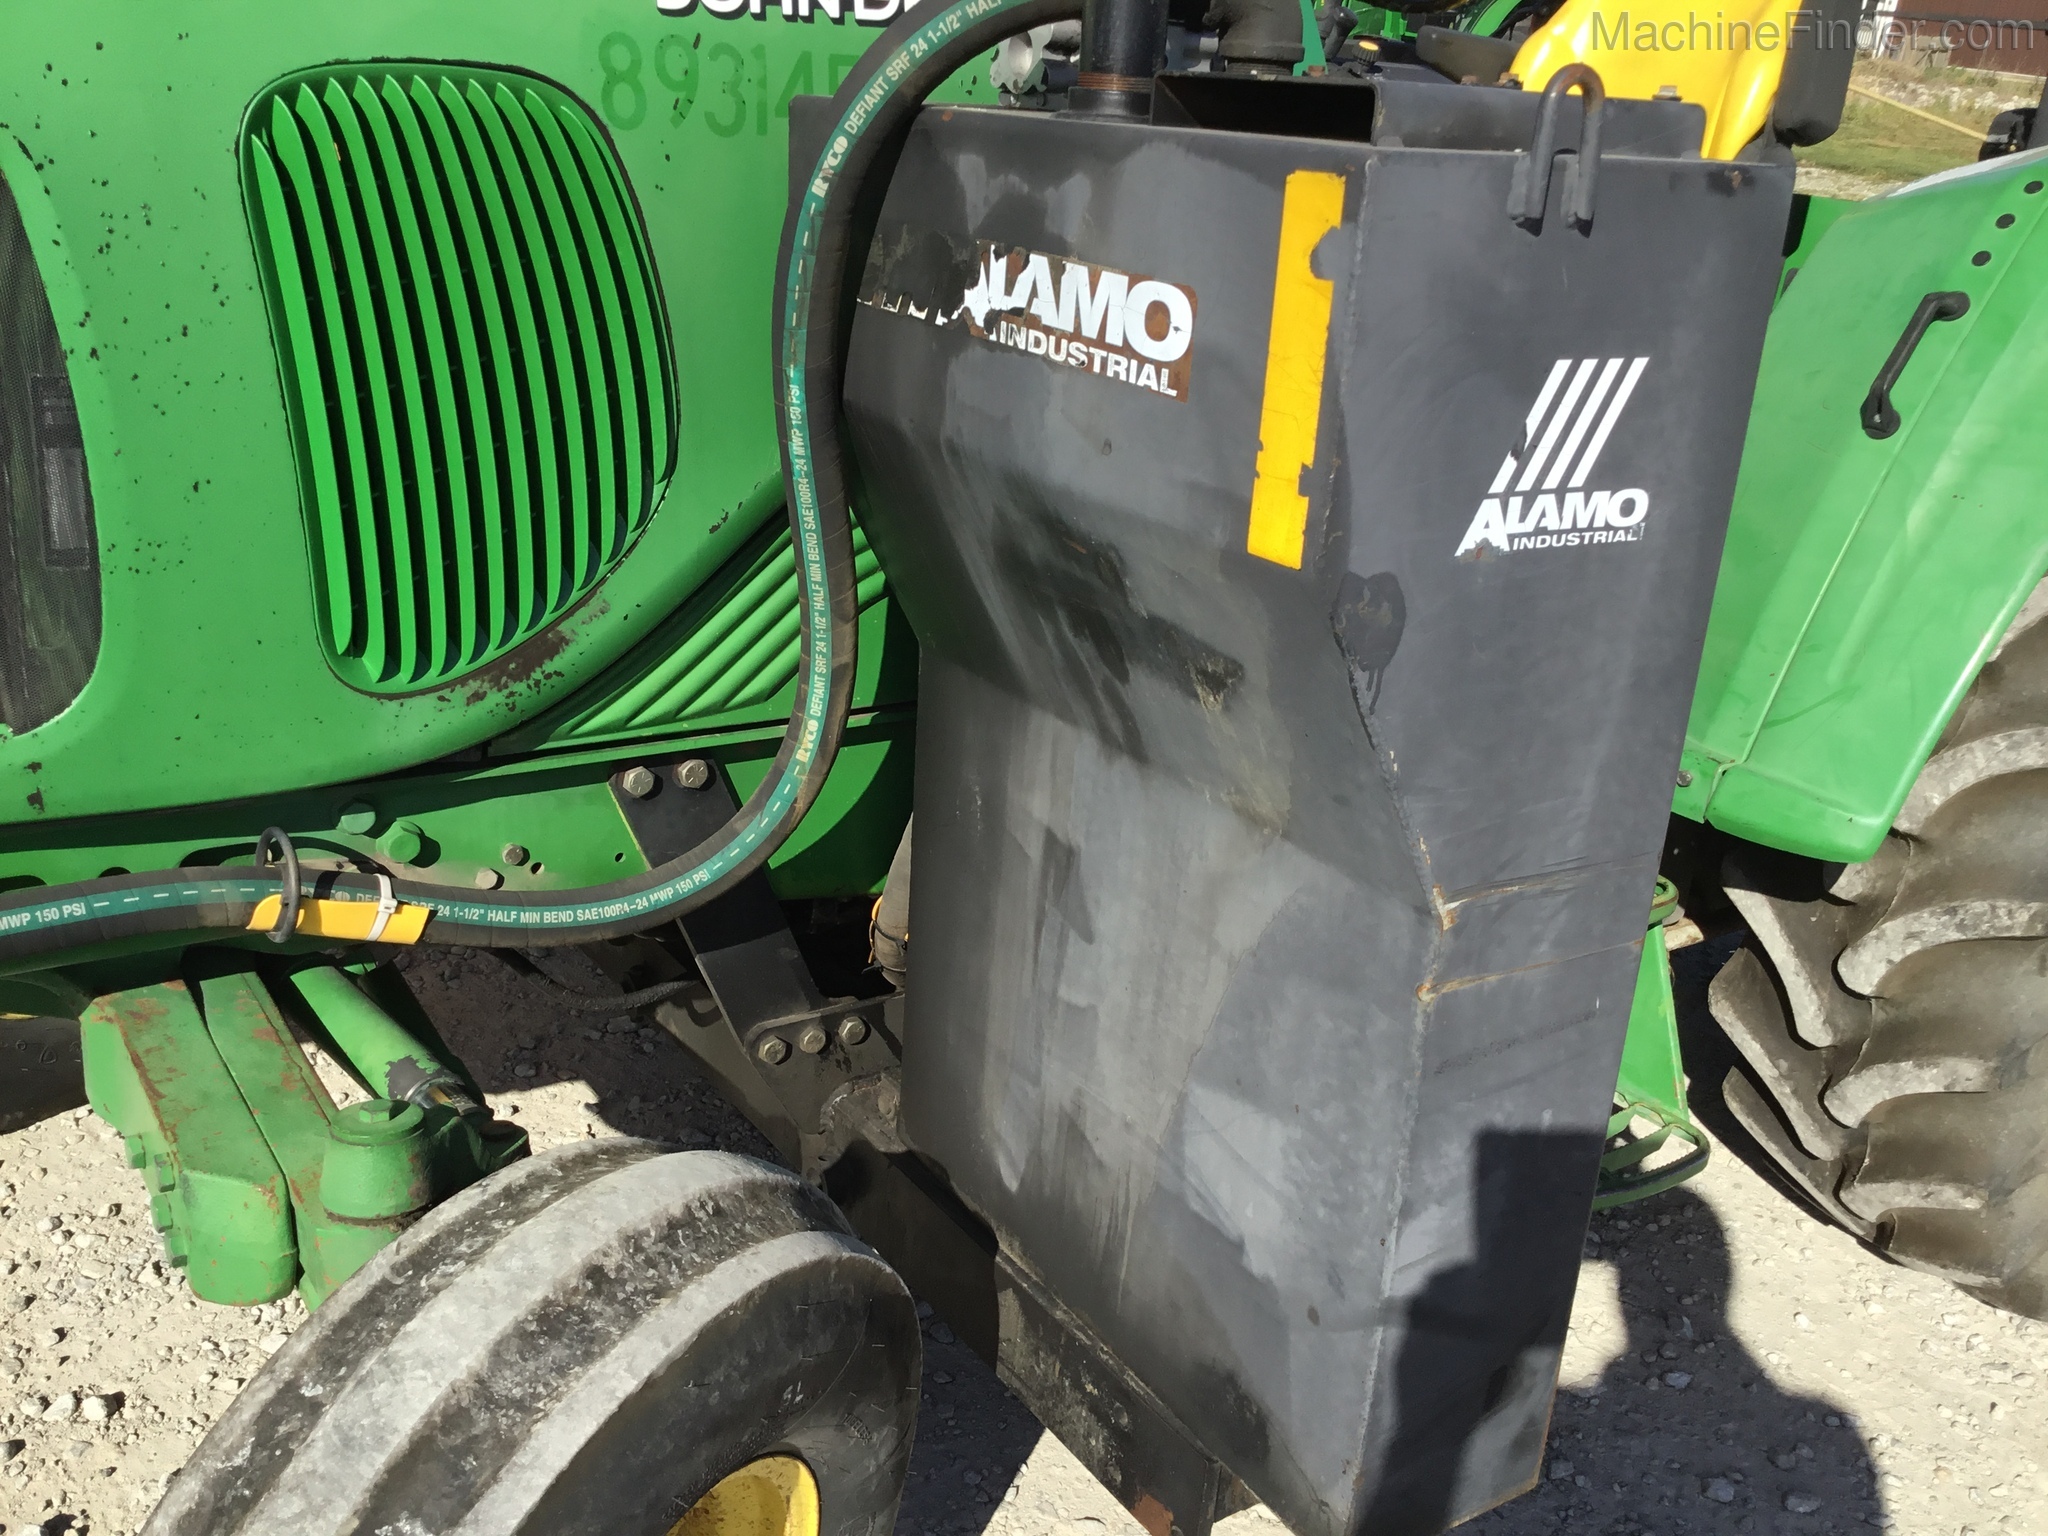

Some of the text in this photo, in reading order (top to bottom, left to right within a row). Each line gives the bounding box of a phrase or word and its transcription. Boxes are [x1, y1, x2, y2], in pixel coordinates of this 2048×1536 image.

[811, 136, 848, 198] RYCO
[844, 76, 890, 135] DEFIANT
[886, 54, 912, 82] SRF
[909, 39, 929, 58] 24
[965, 0, 1001, 19] HAL
[1000, 320, 1177, 397] INDUSTRIAL
[788, 384, 801, 404] PSI
[789, 406, 803, 426] 150
[791, 427, 806, 457] MWP
[795, 458, 816, 530] SAE100R4-24
[1454, 488, 1650, 557] ALAMO
[805, 532, 820, 561] BEND
[1512, 529, 1638, 551] INDUSTRIAL
[810, 562, 823, 583] MIN
[812, 584, 826, 611] HALF
[815, 641, 828, 654] 24
[815, 652, 827, 675] SRF
[809, 675, 826, 717] DEFIANT
[795, 719, 819, 763] RYCO
[437, 904, 451, 917] 24
[453, 906, 485, 921] 1-1/2"
[487, 909, 517, 923] HALF
[519, 911, 541, 924] MIN
[543, 910, 574, 924] BEND
[648, 886, 674, 905] MWP
[675, 878, 694, 895] 150
[692, 868, 712, 886] PSI
[35, 905, 60, 924] 150
[62, 901, 87, 919] PSI
